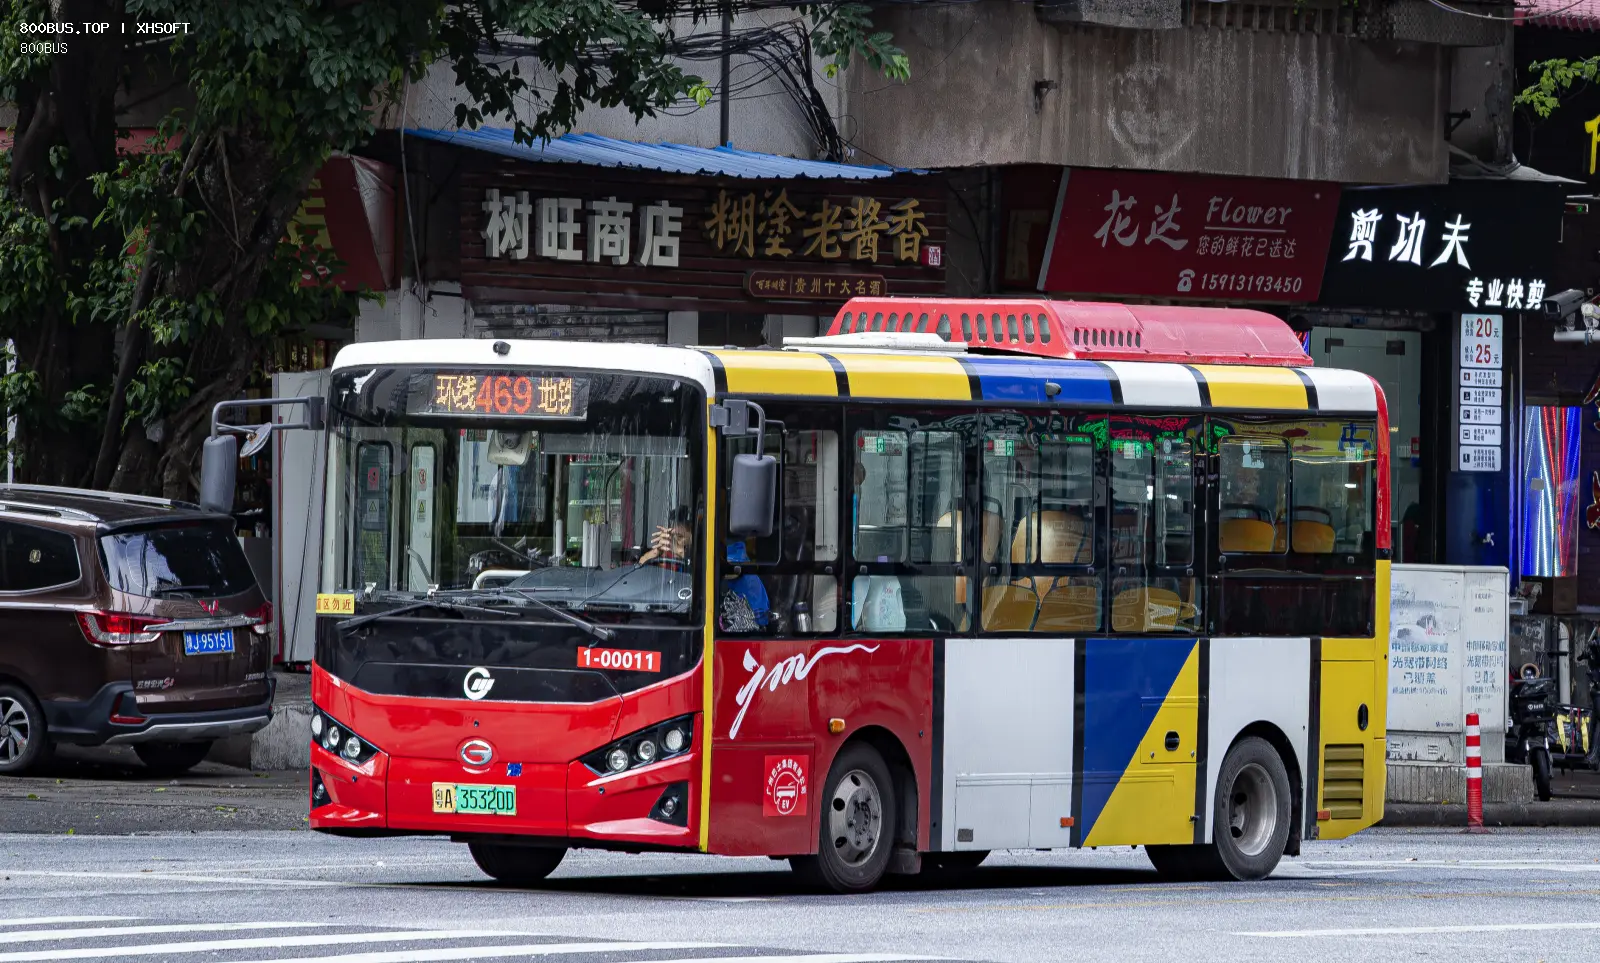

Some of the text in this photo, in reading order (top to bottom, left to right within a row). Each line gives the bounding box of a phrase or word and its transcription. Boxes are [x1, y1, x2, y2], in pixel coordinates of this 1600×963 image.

[1206, 196, 1293, 225] Flower
[480, 188, 684, 268] 树旺商店
[1340, 208, 1472, 271] 剪功夫
[1196, 235, 1297, 259] 您的鲜花已送达
[794, 278, 881, 295] 贵州十大名酒
[1201, 273, 1302, 293] 15913193450
[1465, 276, 1546, 310] 专业快剪
[476, 375, 533, 415] 469
[583, 648, 653, 670] 1-00011
[781, 799, 790, 809] EV
